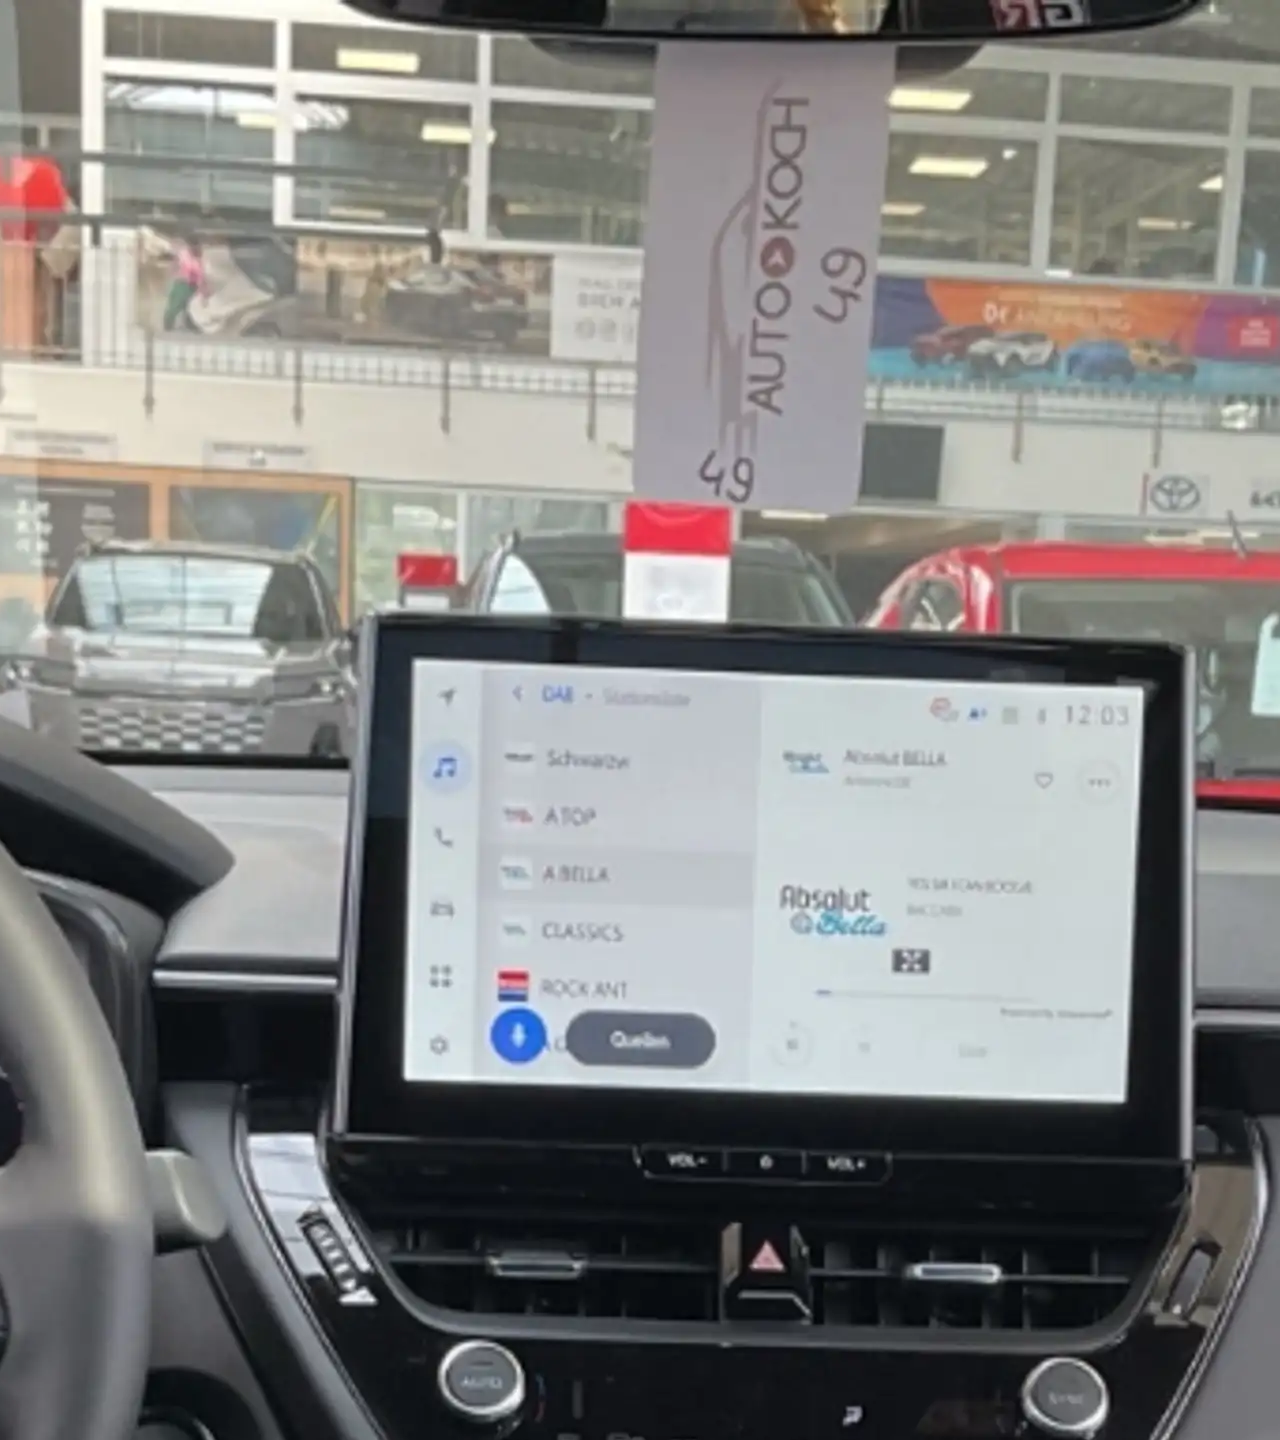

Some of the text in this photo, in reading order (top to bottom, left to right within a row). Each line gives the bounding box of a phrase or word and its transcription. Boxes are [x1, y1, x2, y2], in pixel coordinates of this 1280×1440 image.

[747, 97, 810, 416] AUTO KOCH
[813, 246, 868, 324] 49
[698, 450, 756, 503] 49
[1064, 705, 1130, 727] 12:03
[559, 864, 610, 884] BELLA
[779, 884, 872, 912] Absolut
[541, 921, 625, 943] CLASSICS
